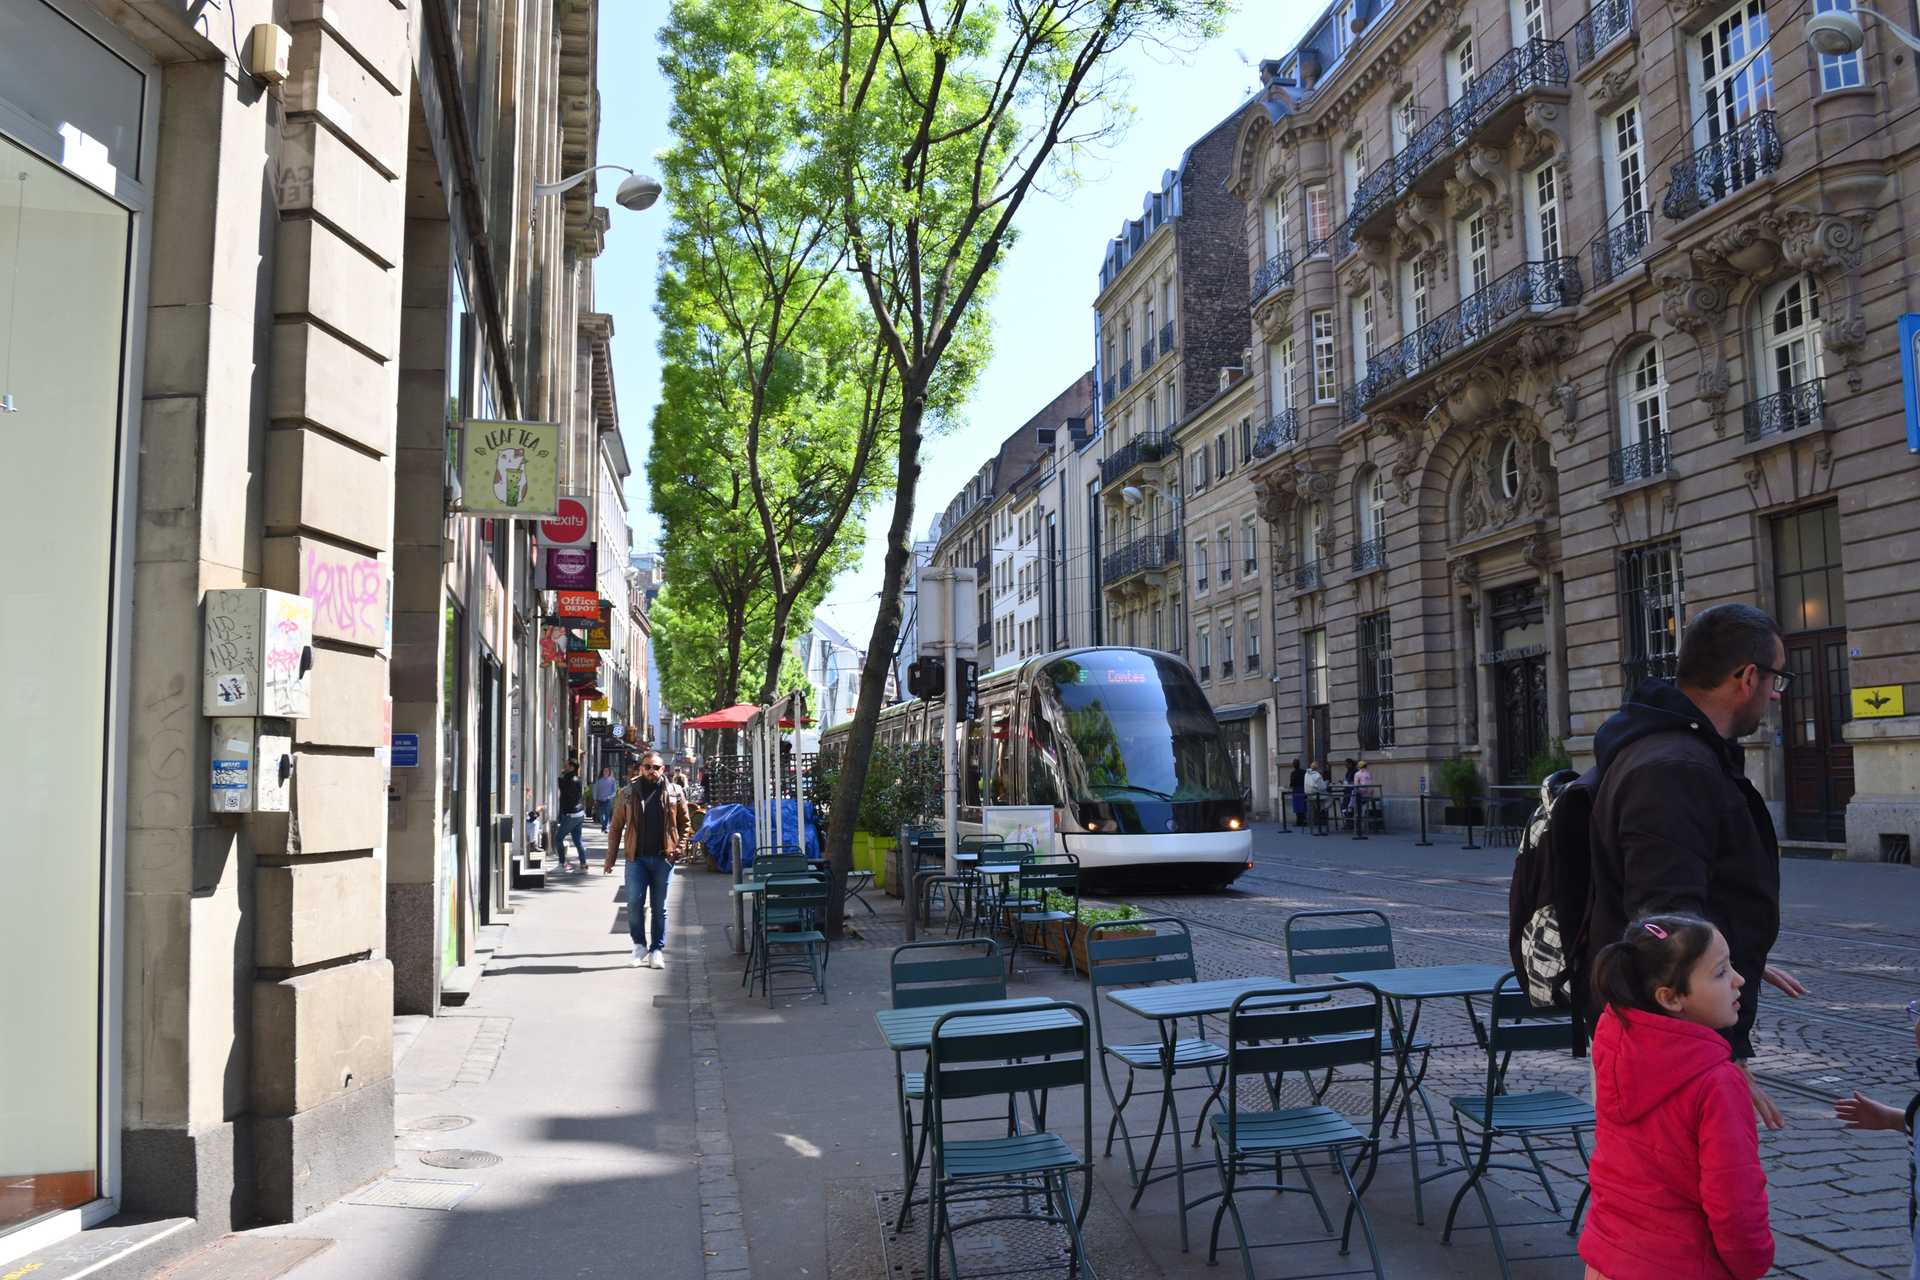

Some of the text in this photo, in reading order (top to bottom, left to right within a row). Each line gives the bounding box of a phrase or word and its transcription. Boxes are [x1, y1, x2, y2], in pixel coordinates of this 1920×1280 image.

[484, 427, 541, 451] LEAF TEA
[561, 596, 598, 605] Office
